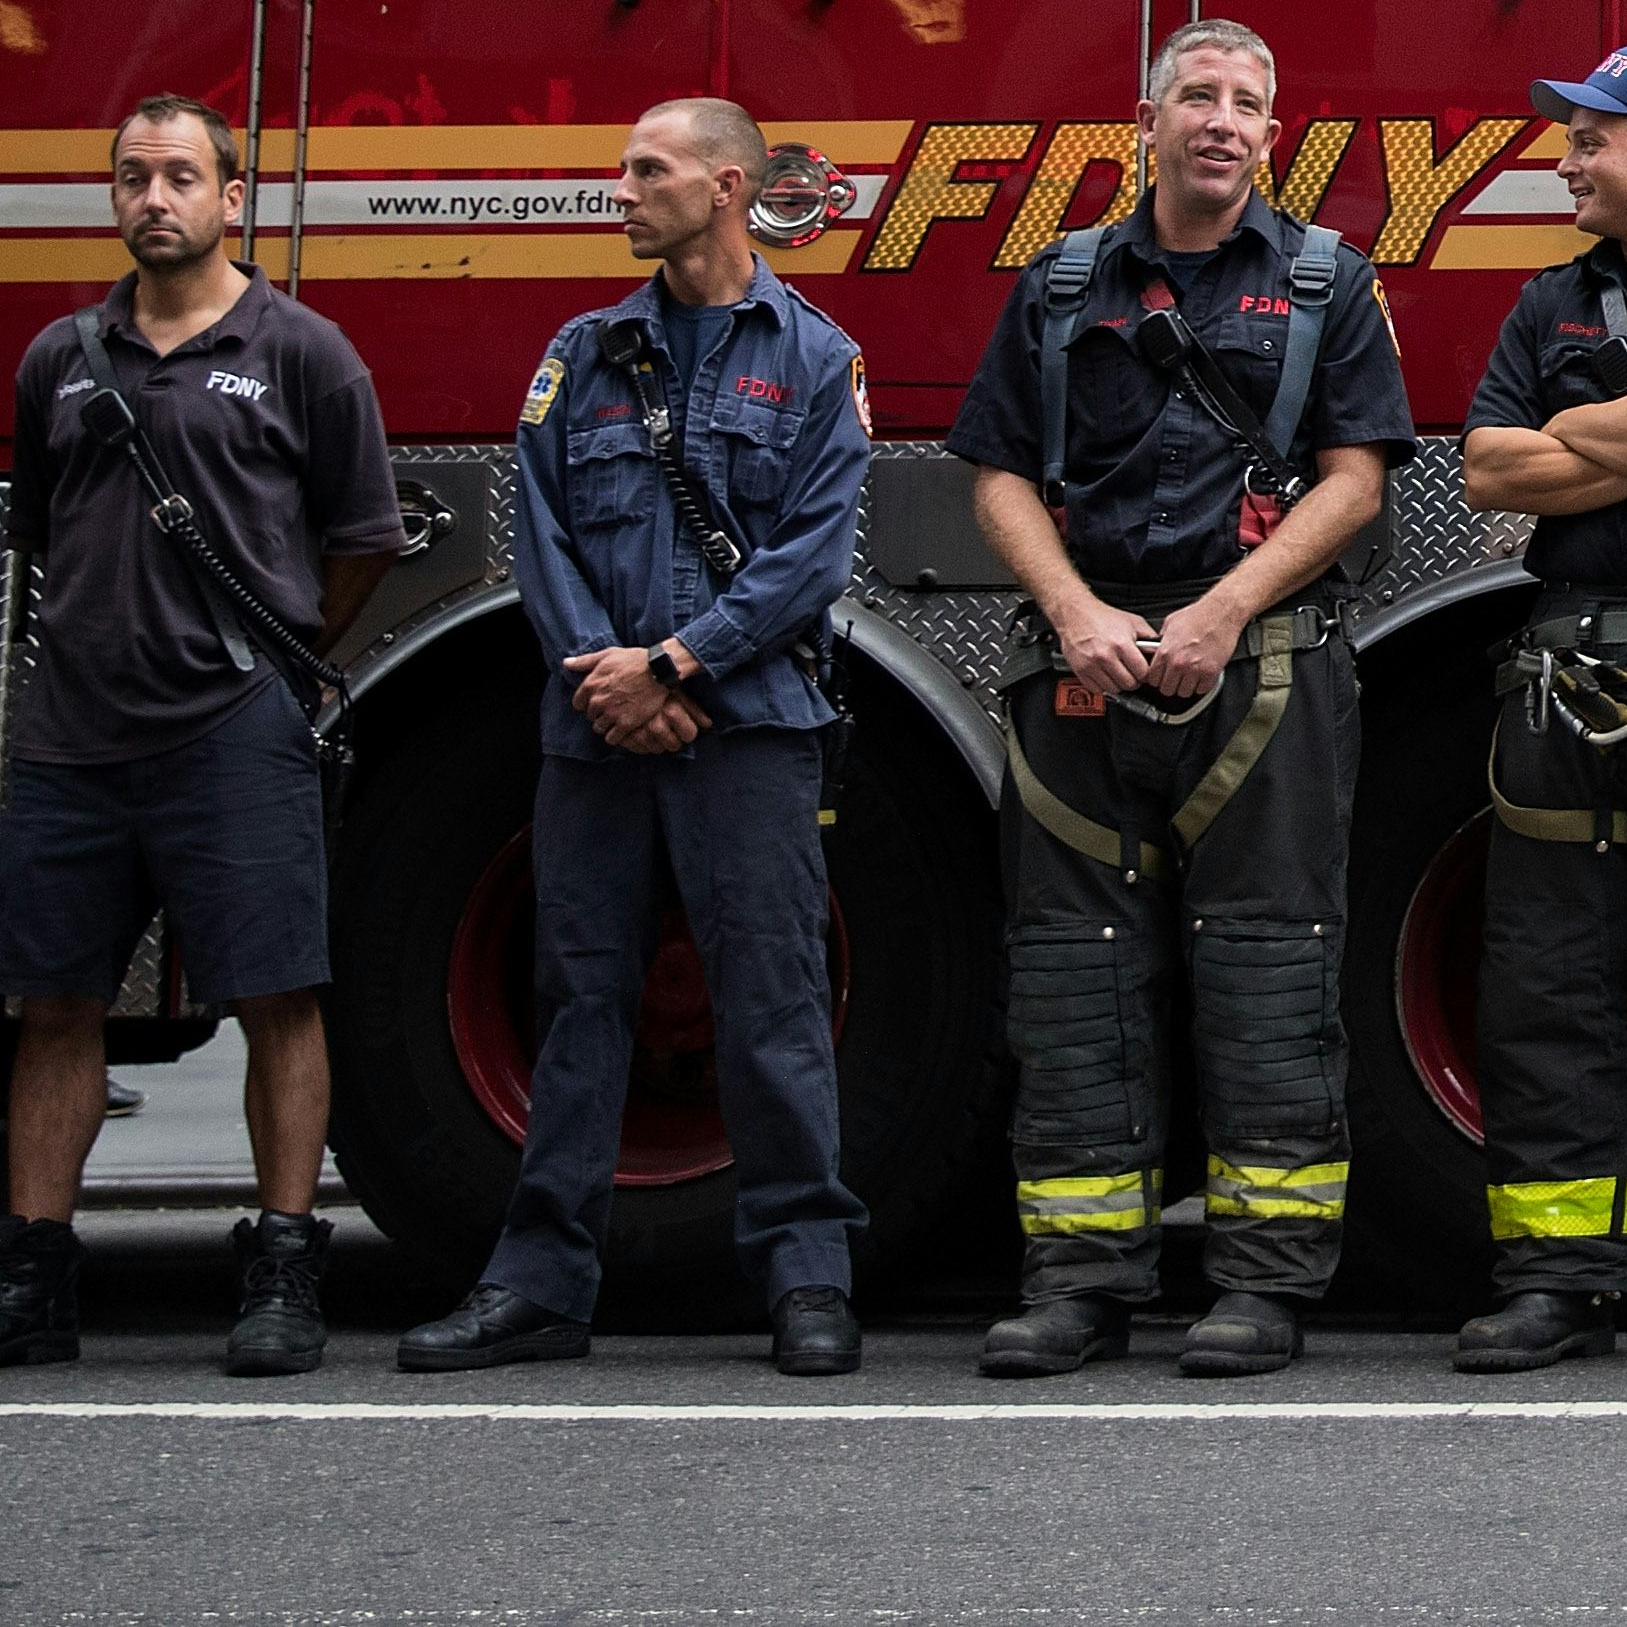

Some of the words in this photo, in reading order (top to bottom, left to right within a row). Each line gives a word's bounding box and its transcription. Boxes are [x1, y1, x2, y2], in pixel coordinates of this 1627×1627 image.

[368, 190, 622, 220] www.nyc.gov.fdn
[1240, 293, 1290, 316] FDN
[206, 370, 269, 402] FDNY
[736, 375, 797, 406] FDNY
